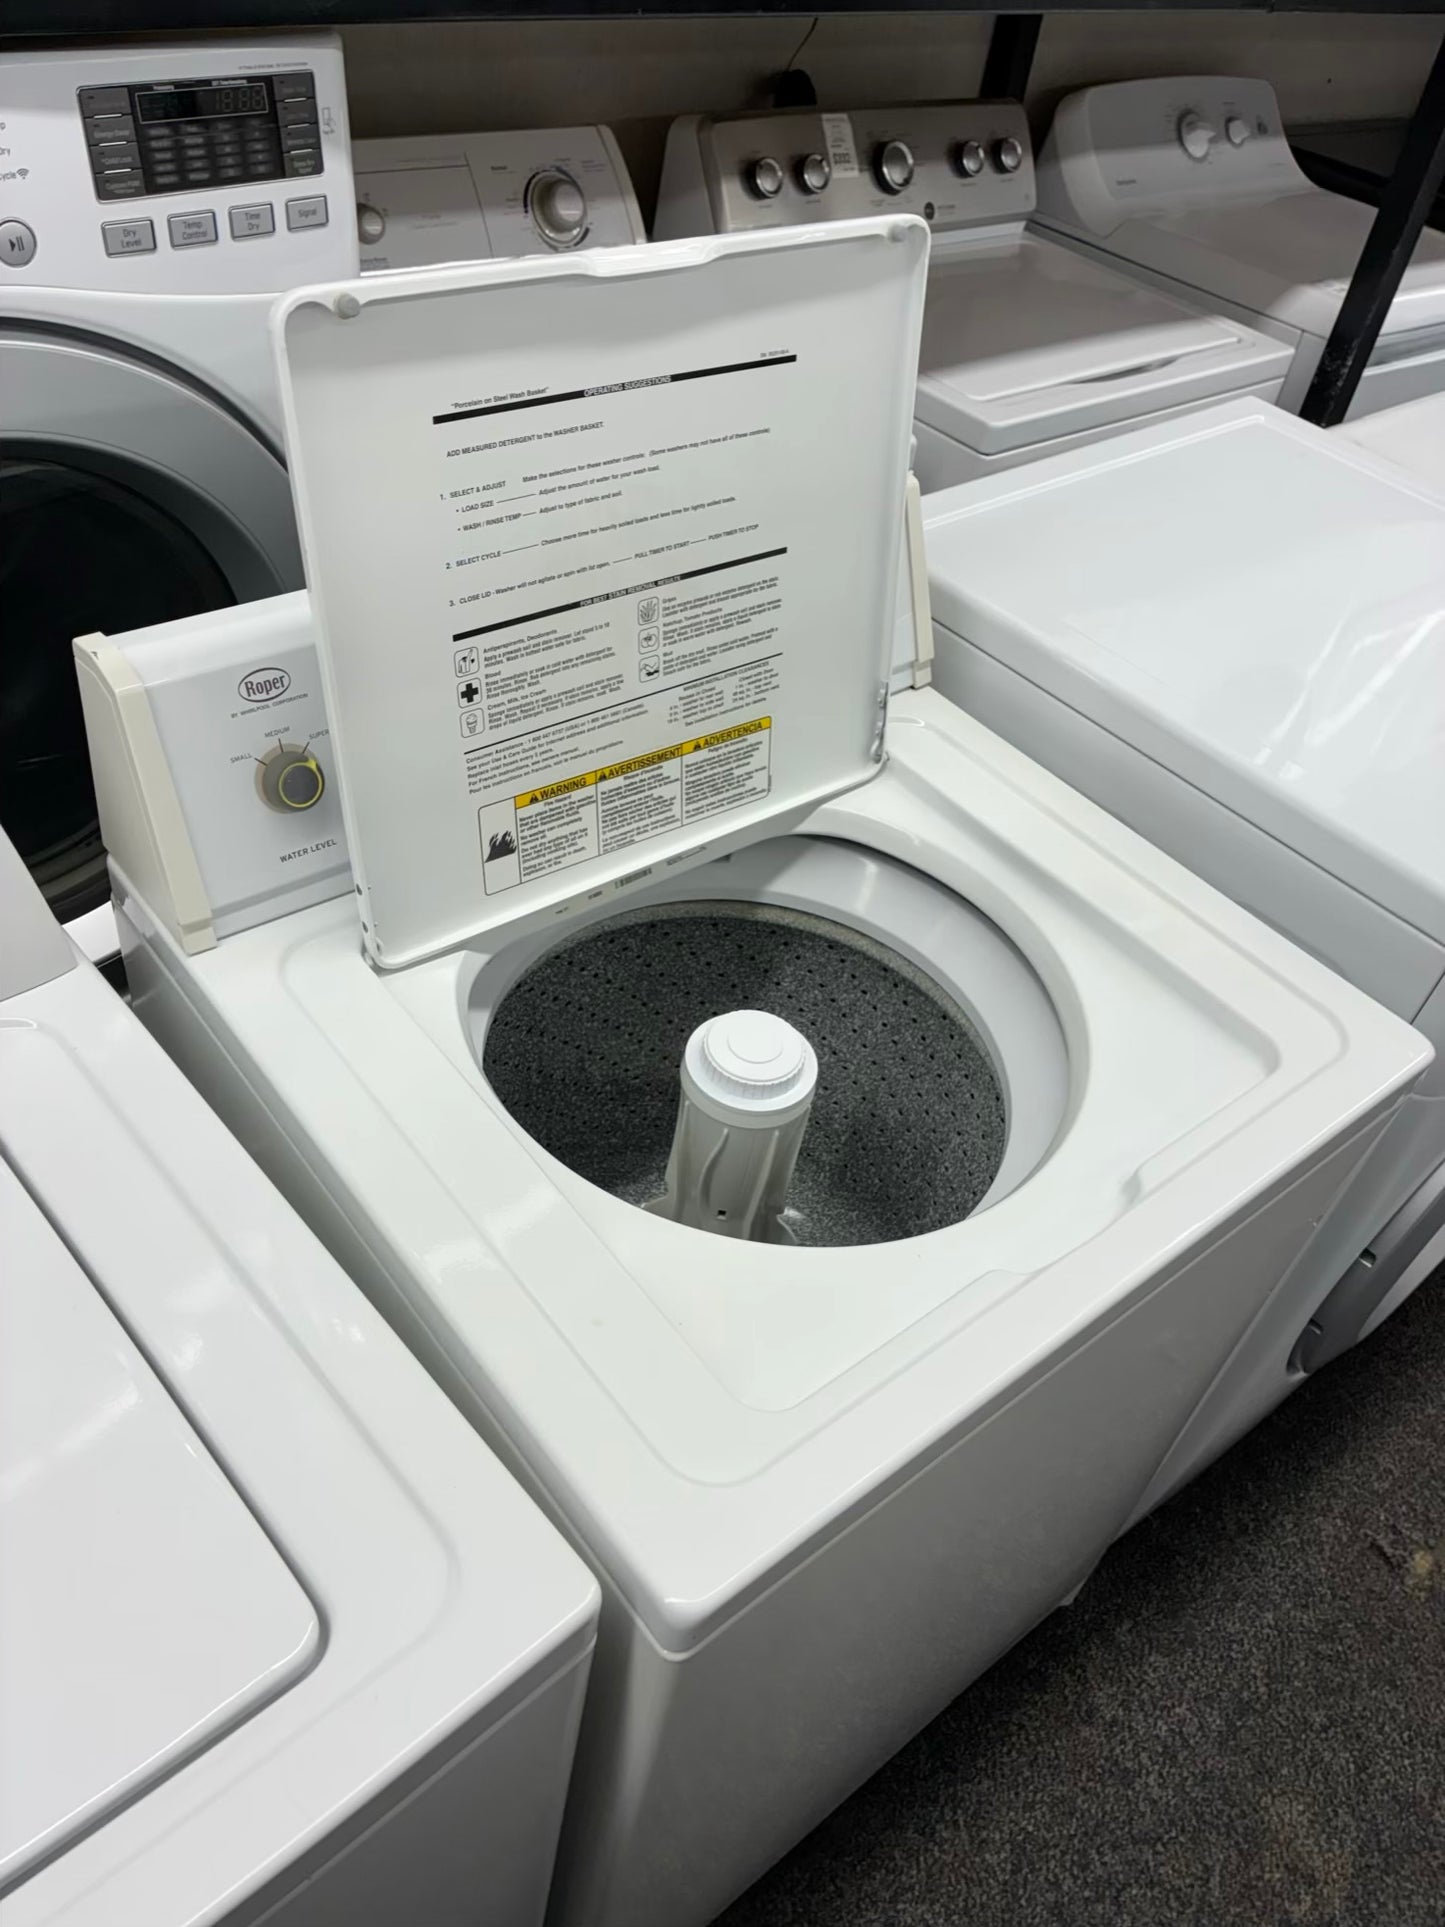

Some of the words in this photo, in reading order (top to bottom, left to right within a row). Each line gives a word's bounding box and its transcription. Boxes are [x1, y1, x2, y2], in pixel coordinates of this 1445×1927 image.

[245, 212, 261, 221] Time
[298, 209, 317, 218] Signal
[123, 228, 137, 239] Dry
[182, 221, 204, 231] Temp
[248, 222, 260, 232] Dry
[182, 230, 208, 241] Control
[120, 238, 142, 250] Level
[584, 383, 622, 396] OPERATING
[624, 375, 670, 389] SUGGESTIONS
[493, 394, 508, 402] Steel
[509, 391, 525, 399] Wash
[446, 448, 460, 457] ADD
[461, 441, 497, 454] MEASURED
[498, 434, 535, 447] DETERGENT
[553, 426, 578, 436] WASHER
[449, 487, 474, 498] SELECT
[481, 480, 505, 491] ADJUST
[522, 474, 537, 482] Make
[548, 466, 576, 476] selections
[586, 461, 601, 469] these
[602, 457, 621, 465] washer
[667, 443, 687, 452] washers
[461, 503, 478, 512] LOAD
[480, 500, 493, 508] SIZE
[539, 486, 556, 496] Adjust
[567, 480, 587, 489] amount
[596, 475, 610, 483] water
[620, 471, 631, 479] your
[633, 467, 646, 475] wash
[463, 521, 481, 530] WASH
[485, 516, 503, 525] RINSE
[505, 512, 521, 521] TEMP
[539, 504, 556, 515] Adjust
[564, 500, 576, 509] type
[584, 495, 599, 503] fabric
[455, 556, 479, 566] SELECT
[480, 551, 500, 560] CYCLE
[541, 536, 561, 545] Choose
[459, 593, 479, 604] CLOSE
[495, 584, 515, 594] Washer
[537, 574, 555, 585] agitate
[563, 569, 575, 578] spin
[576, 566, 587, 574] with
[648, 547, 664, 555] TIMER
[673, 540, 689, 549] START
[580, 598, 591, 607] FOR
[593, 594, 607, 603] BEST
[608, 589, 626, 599] STAIN
[485, 670, 500, 679] Blood
[244, 675, 286, 698] Roper
[529, 688, 546, 697] Cream
[240, 704, 270, 716] WHIRLPOOL
[272, 693, 308, 706] CORPORATION
[264, 726, 290, 738] MEDIUM
[703, 720, 762, 746] ADVERTENCIA
[230, 753, 252, 764] SMALL
[466, 750, 493, 764] Consumer
[507, 750, 520, 758] Care
[608, 746, 680, 777] AVERTISSEMENT
[540, 776, 586, 799] WARNING
[279, 847, 309, 864] WATER
[310, 838, 338, 854] LEVEL
